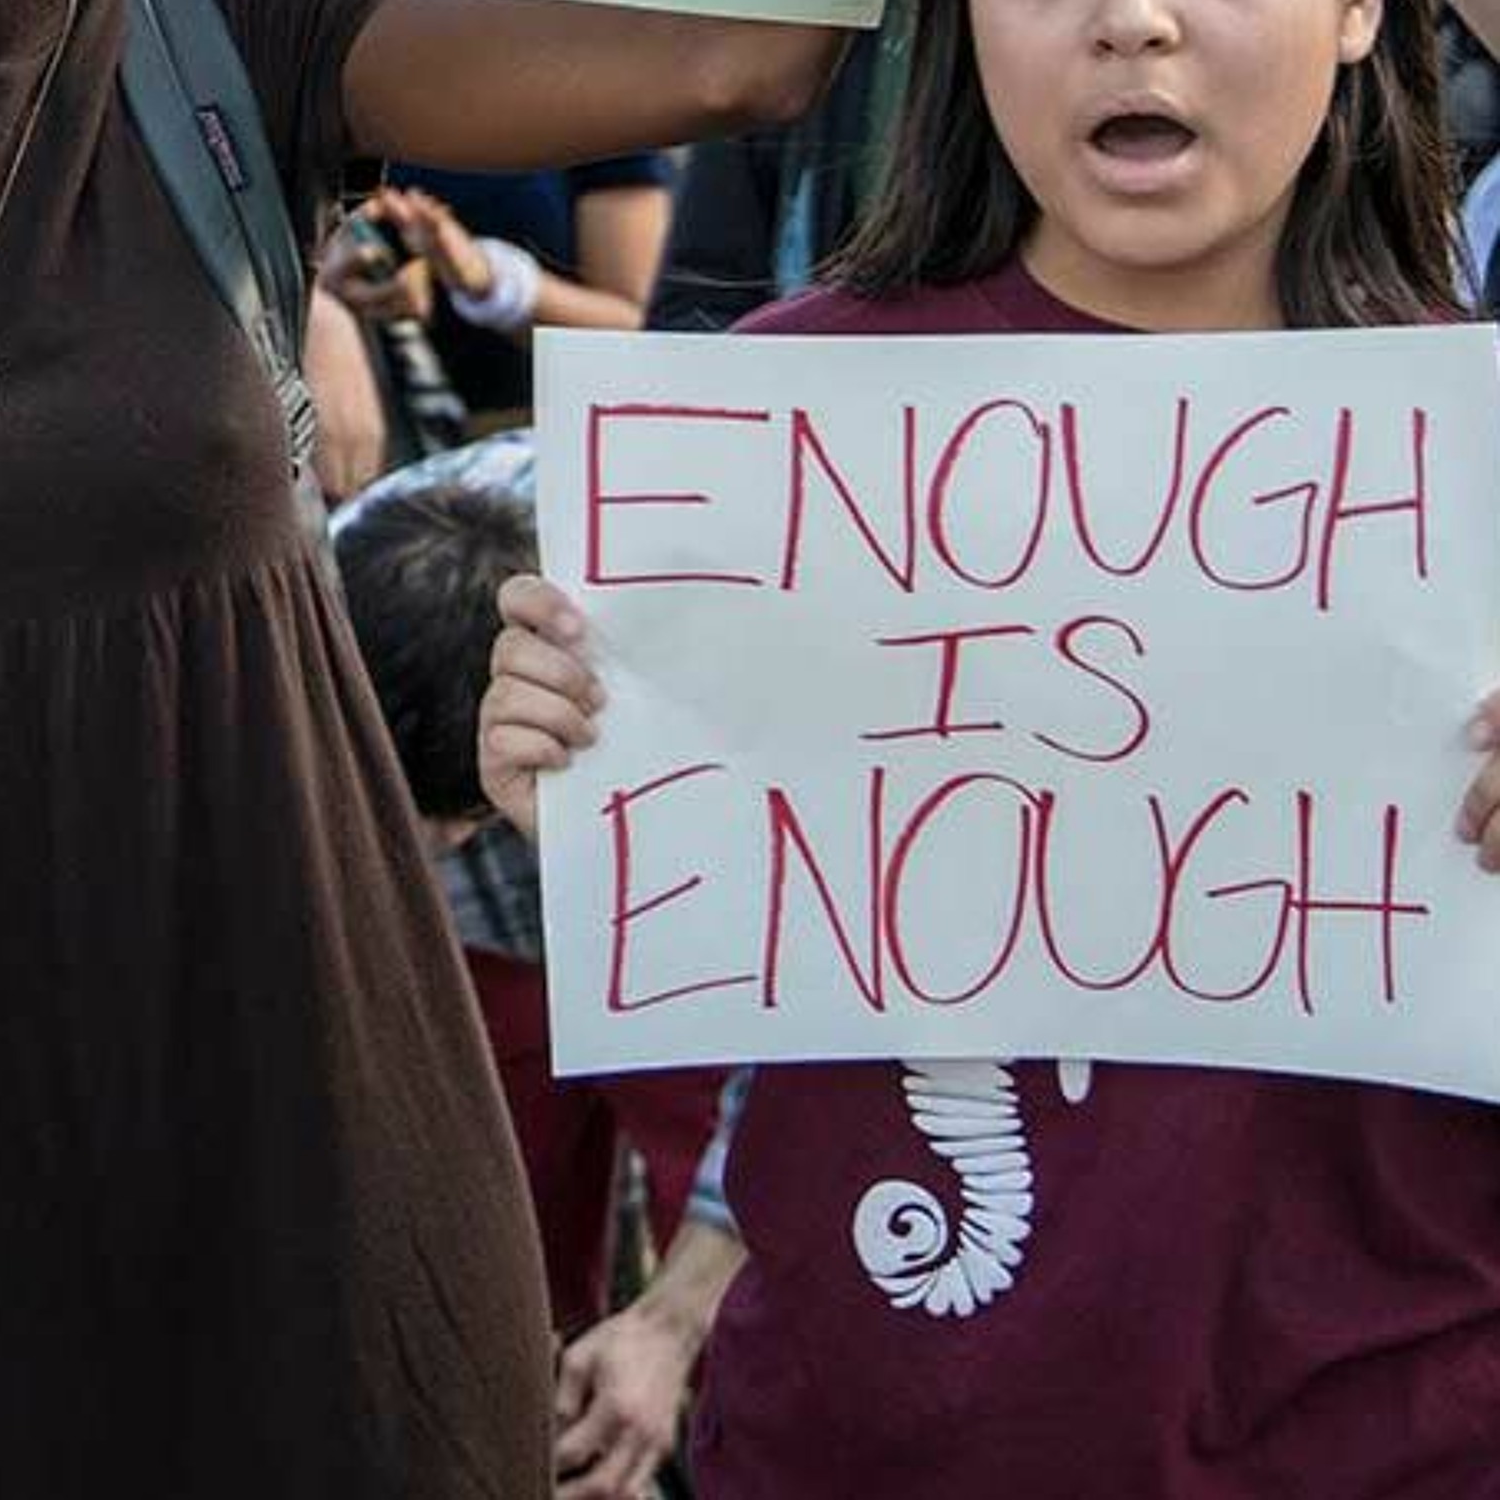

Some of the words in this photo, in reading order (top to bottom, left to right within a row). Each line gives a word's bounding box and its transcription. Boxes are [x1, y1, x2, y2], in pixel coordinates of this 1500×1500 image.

[584, 398, 1429, 611] ENOUGH
[859, 614, 1151, 762] IS
[601, 763, 1431, 1016] ENOUGH
